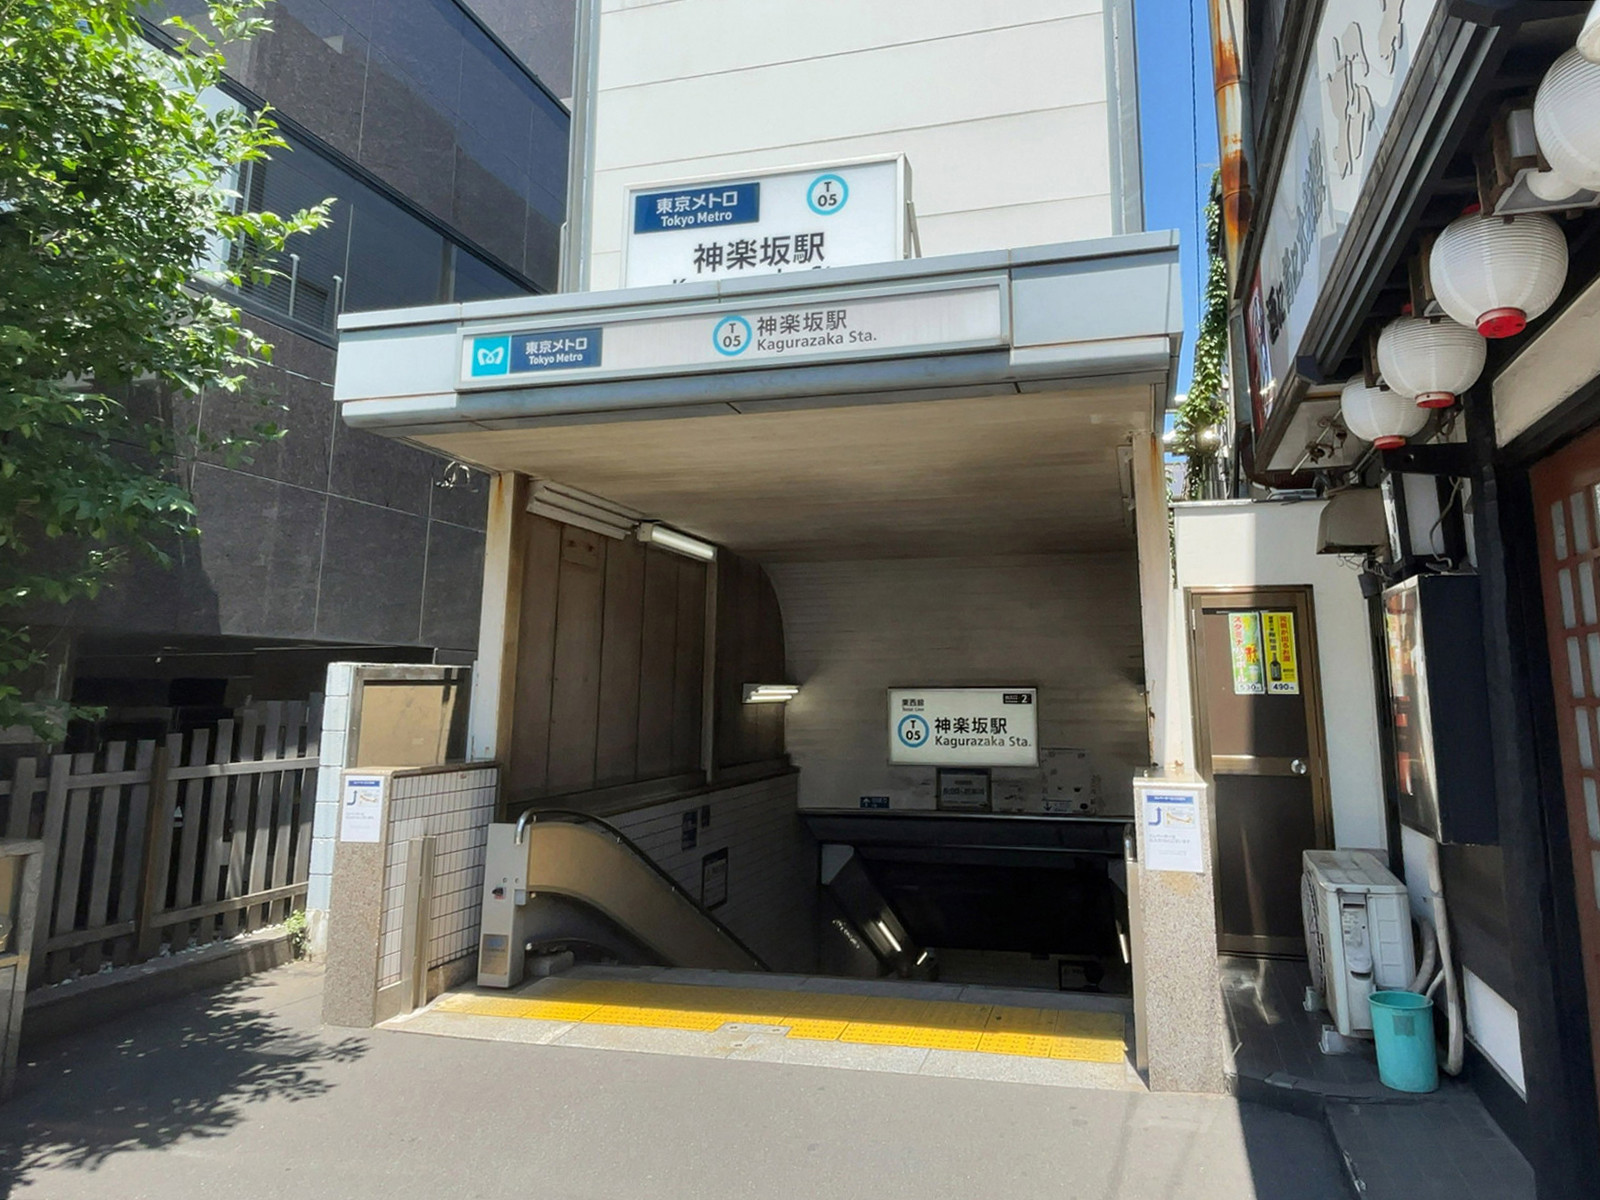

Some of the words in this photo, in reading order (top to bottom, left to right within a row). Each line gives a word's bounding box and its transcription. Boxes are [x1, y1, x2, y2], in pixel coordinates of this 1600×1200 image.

[824, 181, 832, 193] T
[655, 190, 738, 214] 東京メトロ
[817, 194, 837, 207] 05
[660, 213, 695, 228] Tokyo
[697, 210, 733, 224] Metro
[693, 232, 825, 274] 神楽坂駅
[729, 323, 736, 334] T
[757, 309, 848, 337] 神楽坂駅
[525, 337, 588, 355] 東京メトロ
[722, 335, 741, 348] 05
[757, 332, 844, 353] Kagurazaka
[848, 330, 877, 343] Sta.
[528, 354, 555, 366] Tokyo
[556, 353, 583, 363] Metro
[1021, 694, 1028, 704] 2
[910, 720, 916, 729] T
[935, 717, 1007, 735] 神楽坂駅
[905, 730, 921, 741] 05
[935, 736, 1005, 749] Kagurazaka
[1009, 736, 1032, 747] Sta.
